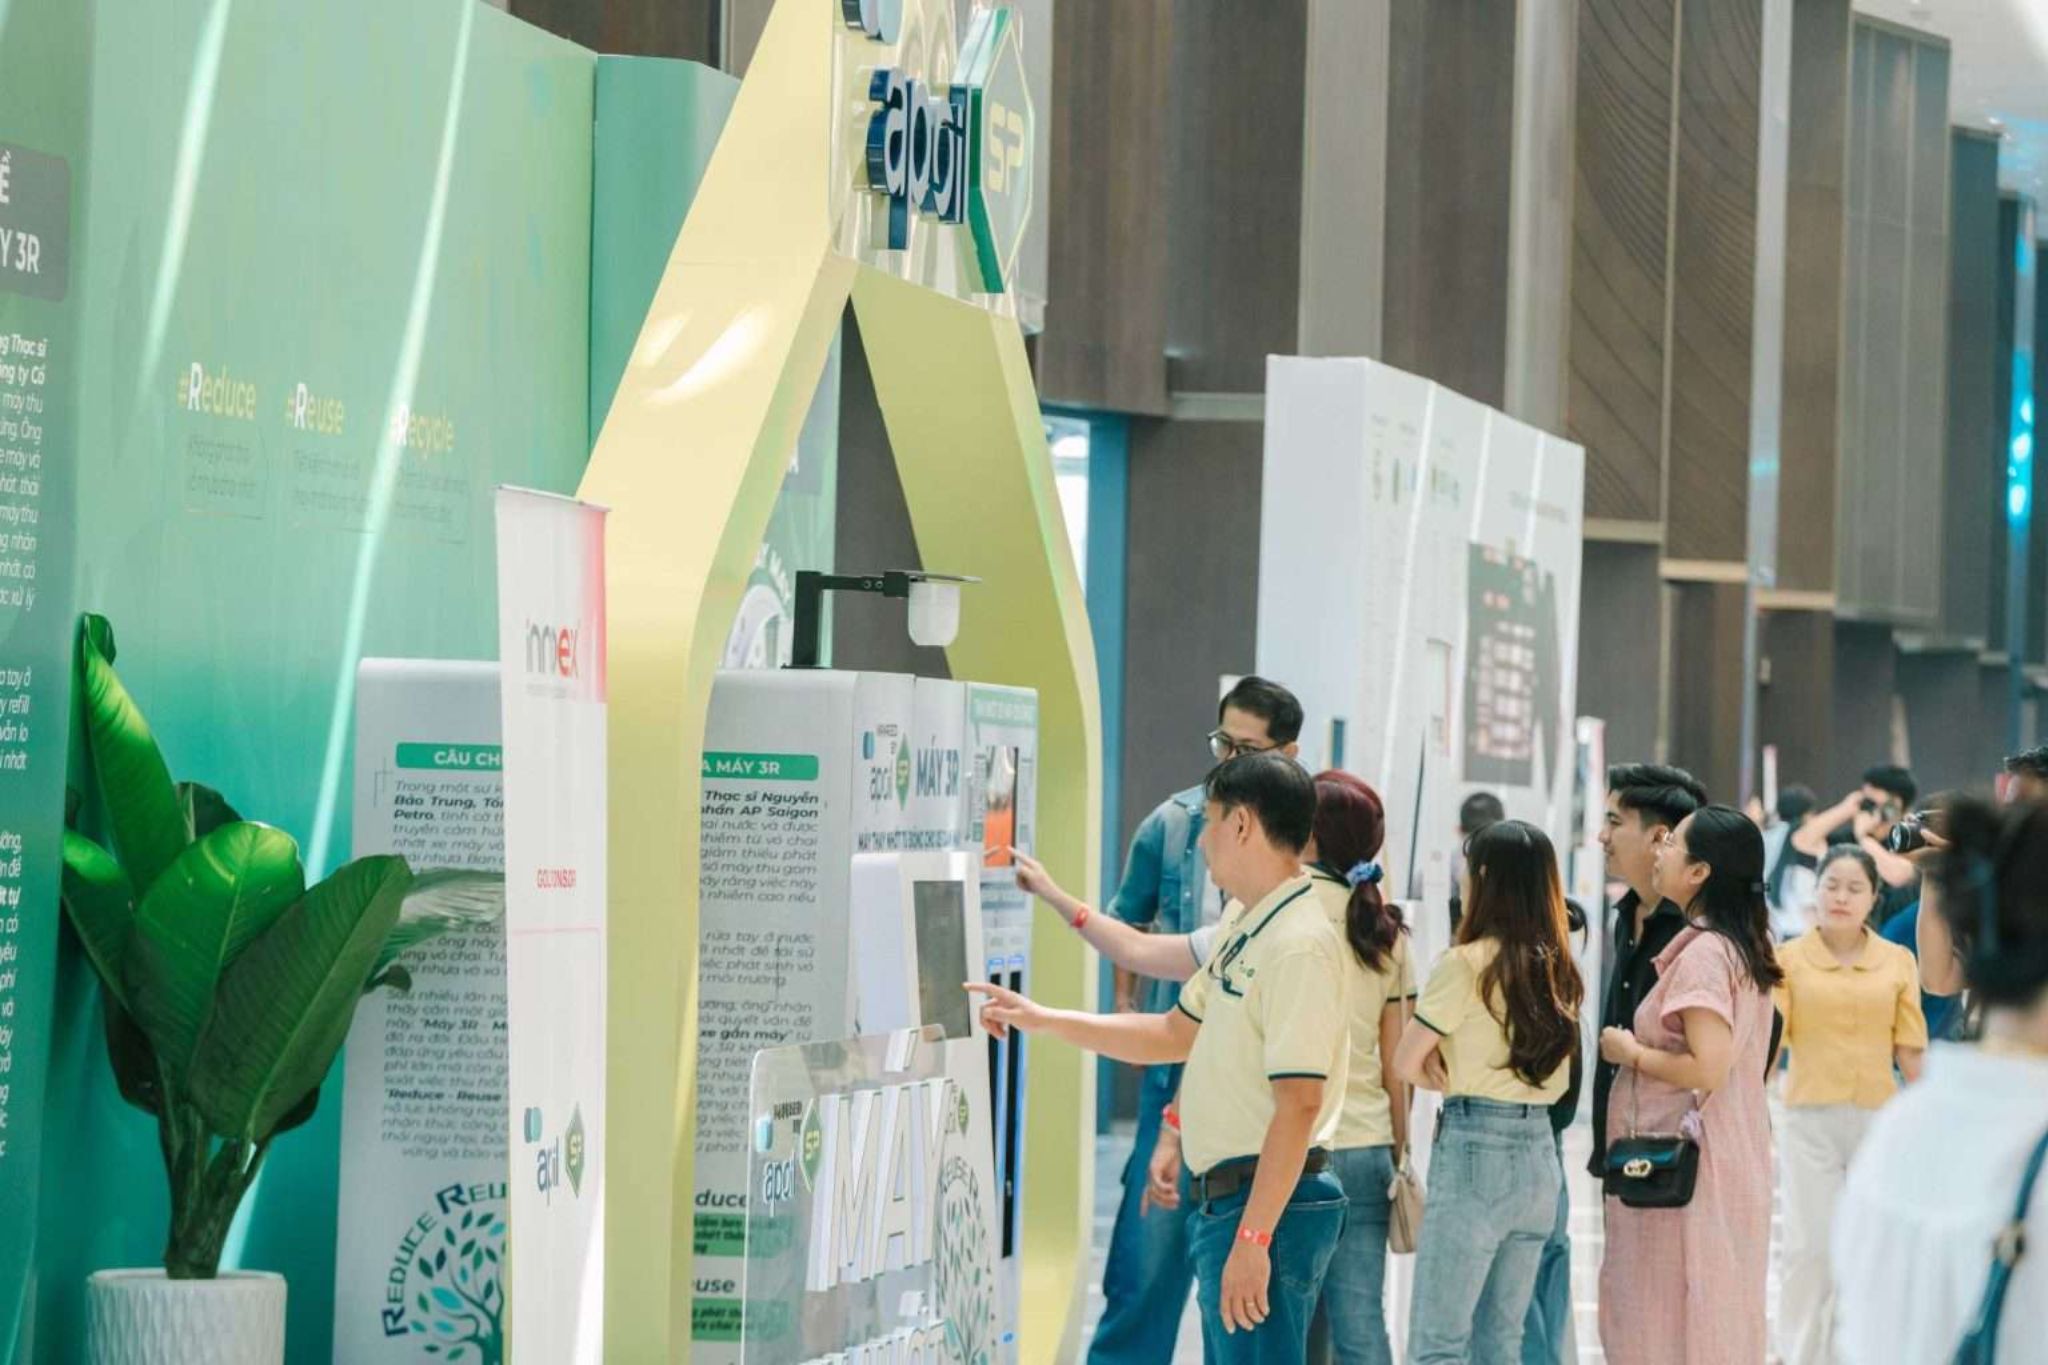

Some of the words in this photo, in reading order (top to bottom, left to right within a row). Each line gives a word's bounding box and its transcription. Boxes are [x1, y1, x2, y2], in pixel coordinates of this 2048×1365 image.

[16, 231, 40, 275] 3R
[434, 748, 470, 766] CÂU
[716, 757, 754, 774] MÁY
[758, 761, 781, 775] 3R
[396, 780, 436, 794] Trong
[704, 790, 741, 802] Thạc
[761, 791, 819, 805] Nguyễn
[740, 806, 762, 816] AP
[768, 806, 818, 819] Saigon
[382, 1210, 438, 1337] REDUCE
